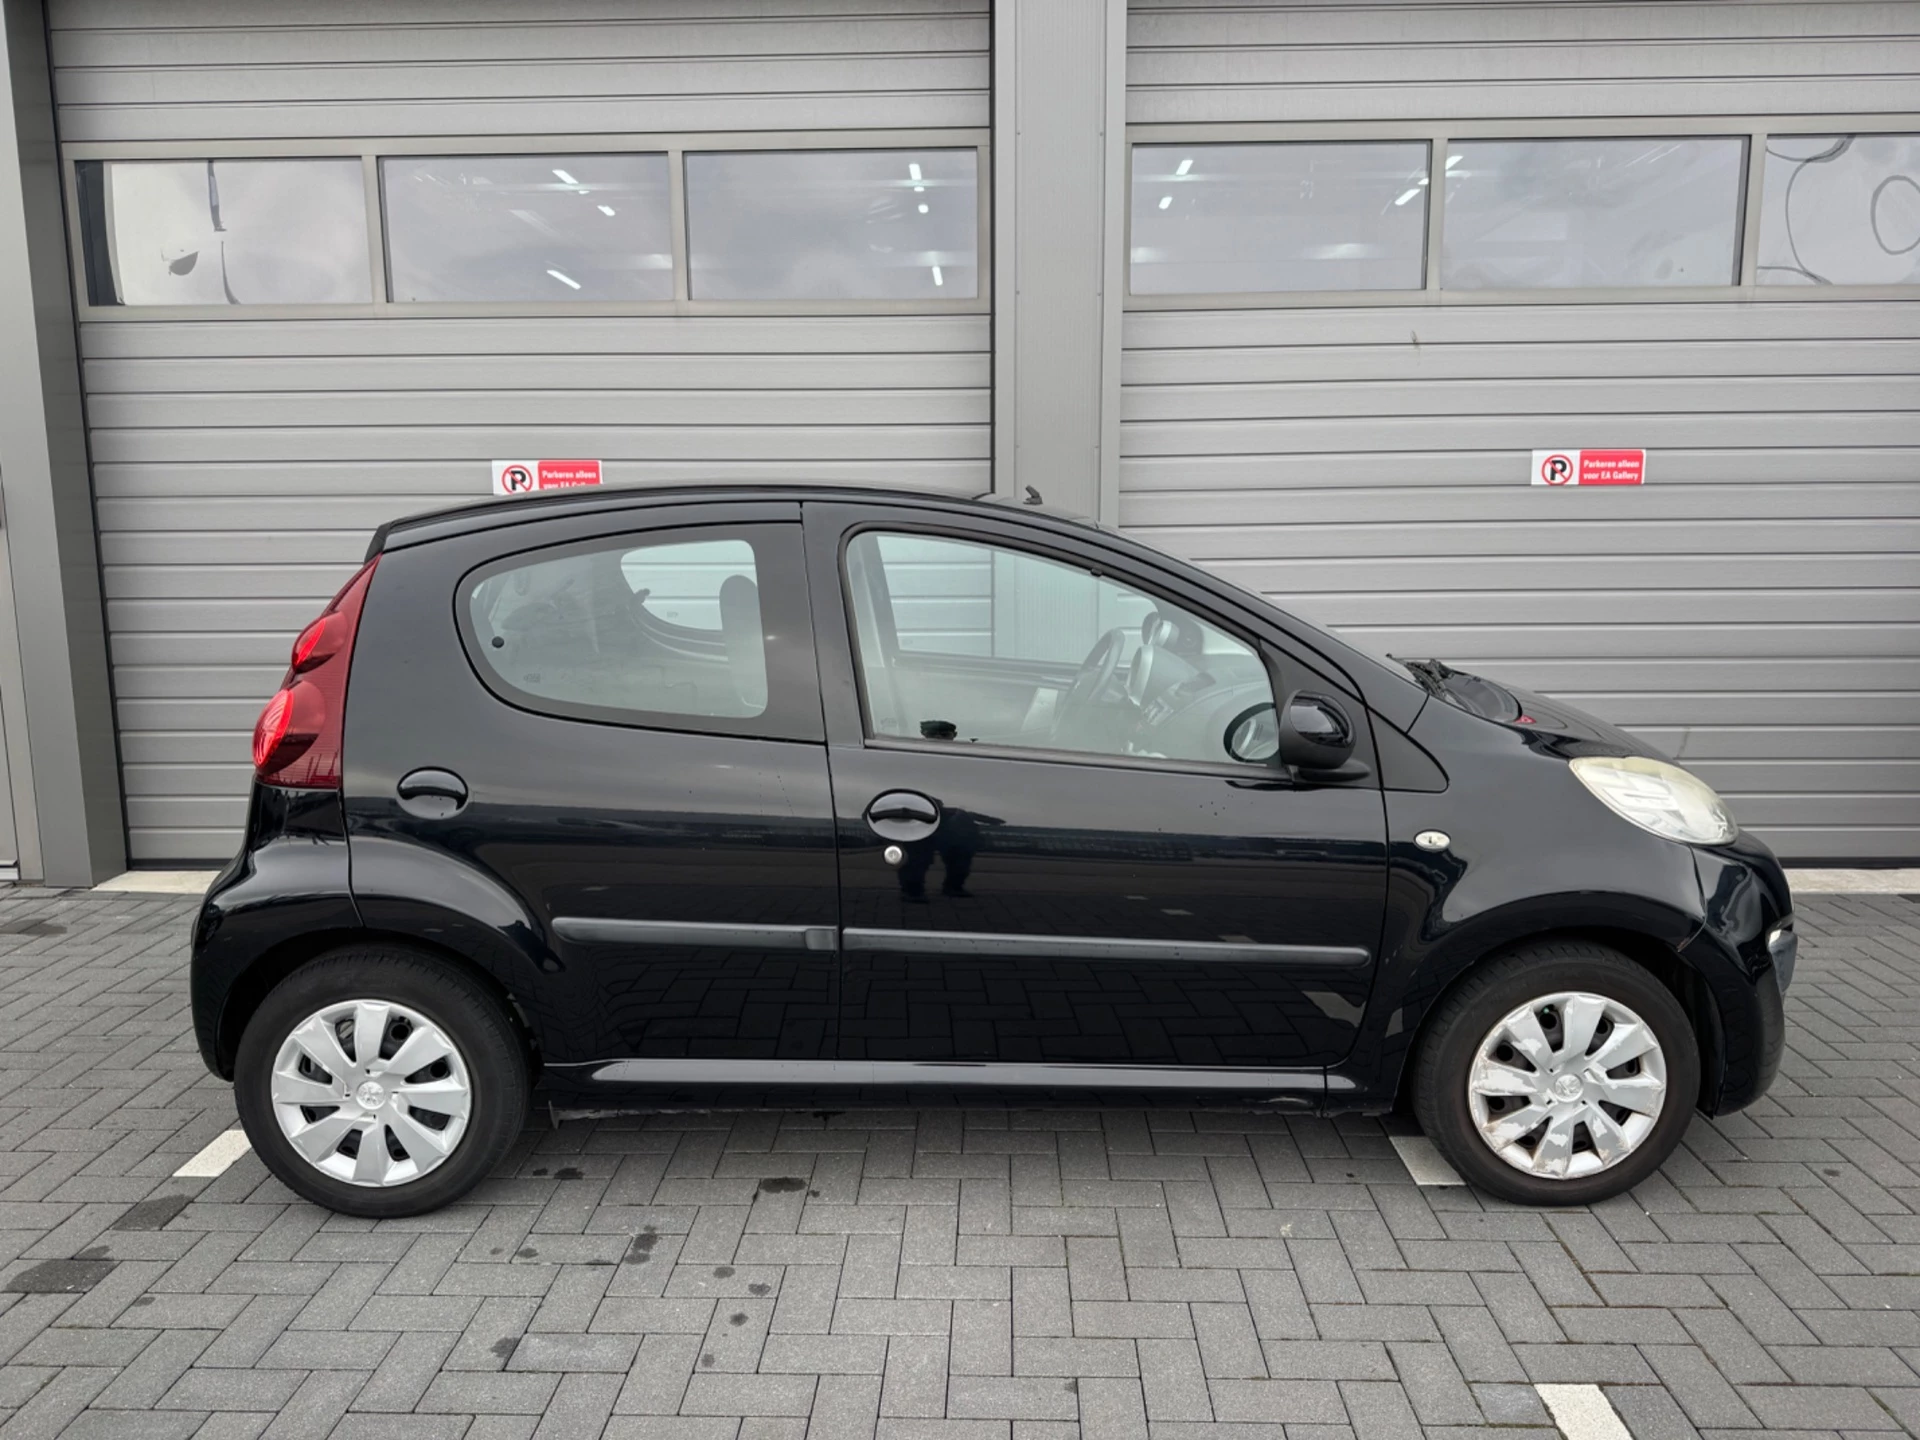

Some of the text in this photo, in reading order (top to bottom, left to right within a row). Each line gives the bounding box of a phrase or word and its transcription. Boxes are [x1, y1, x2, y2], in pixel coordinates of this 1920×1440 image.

[1583, 460, 1640, 469] Parkeren alleen
[542, 470, 597, 479] Parkeren alleen
[1583, 471, 1639, 481] voor EA Gallery
